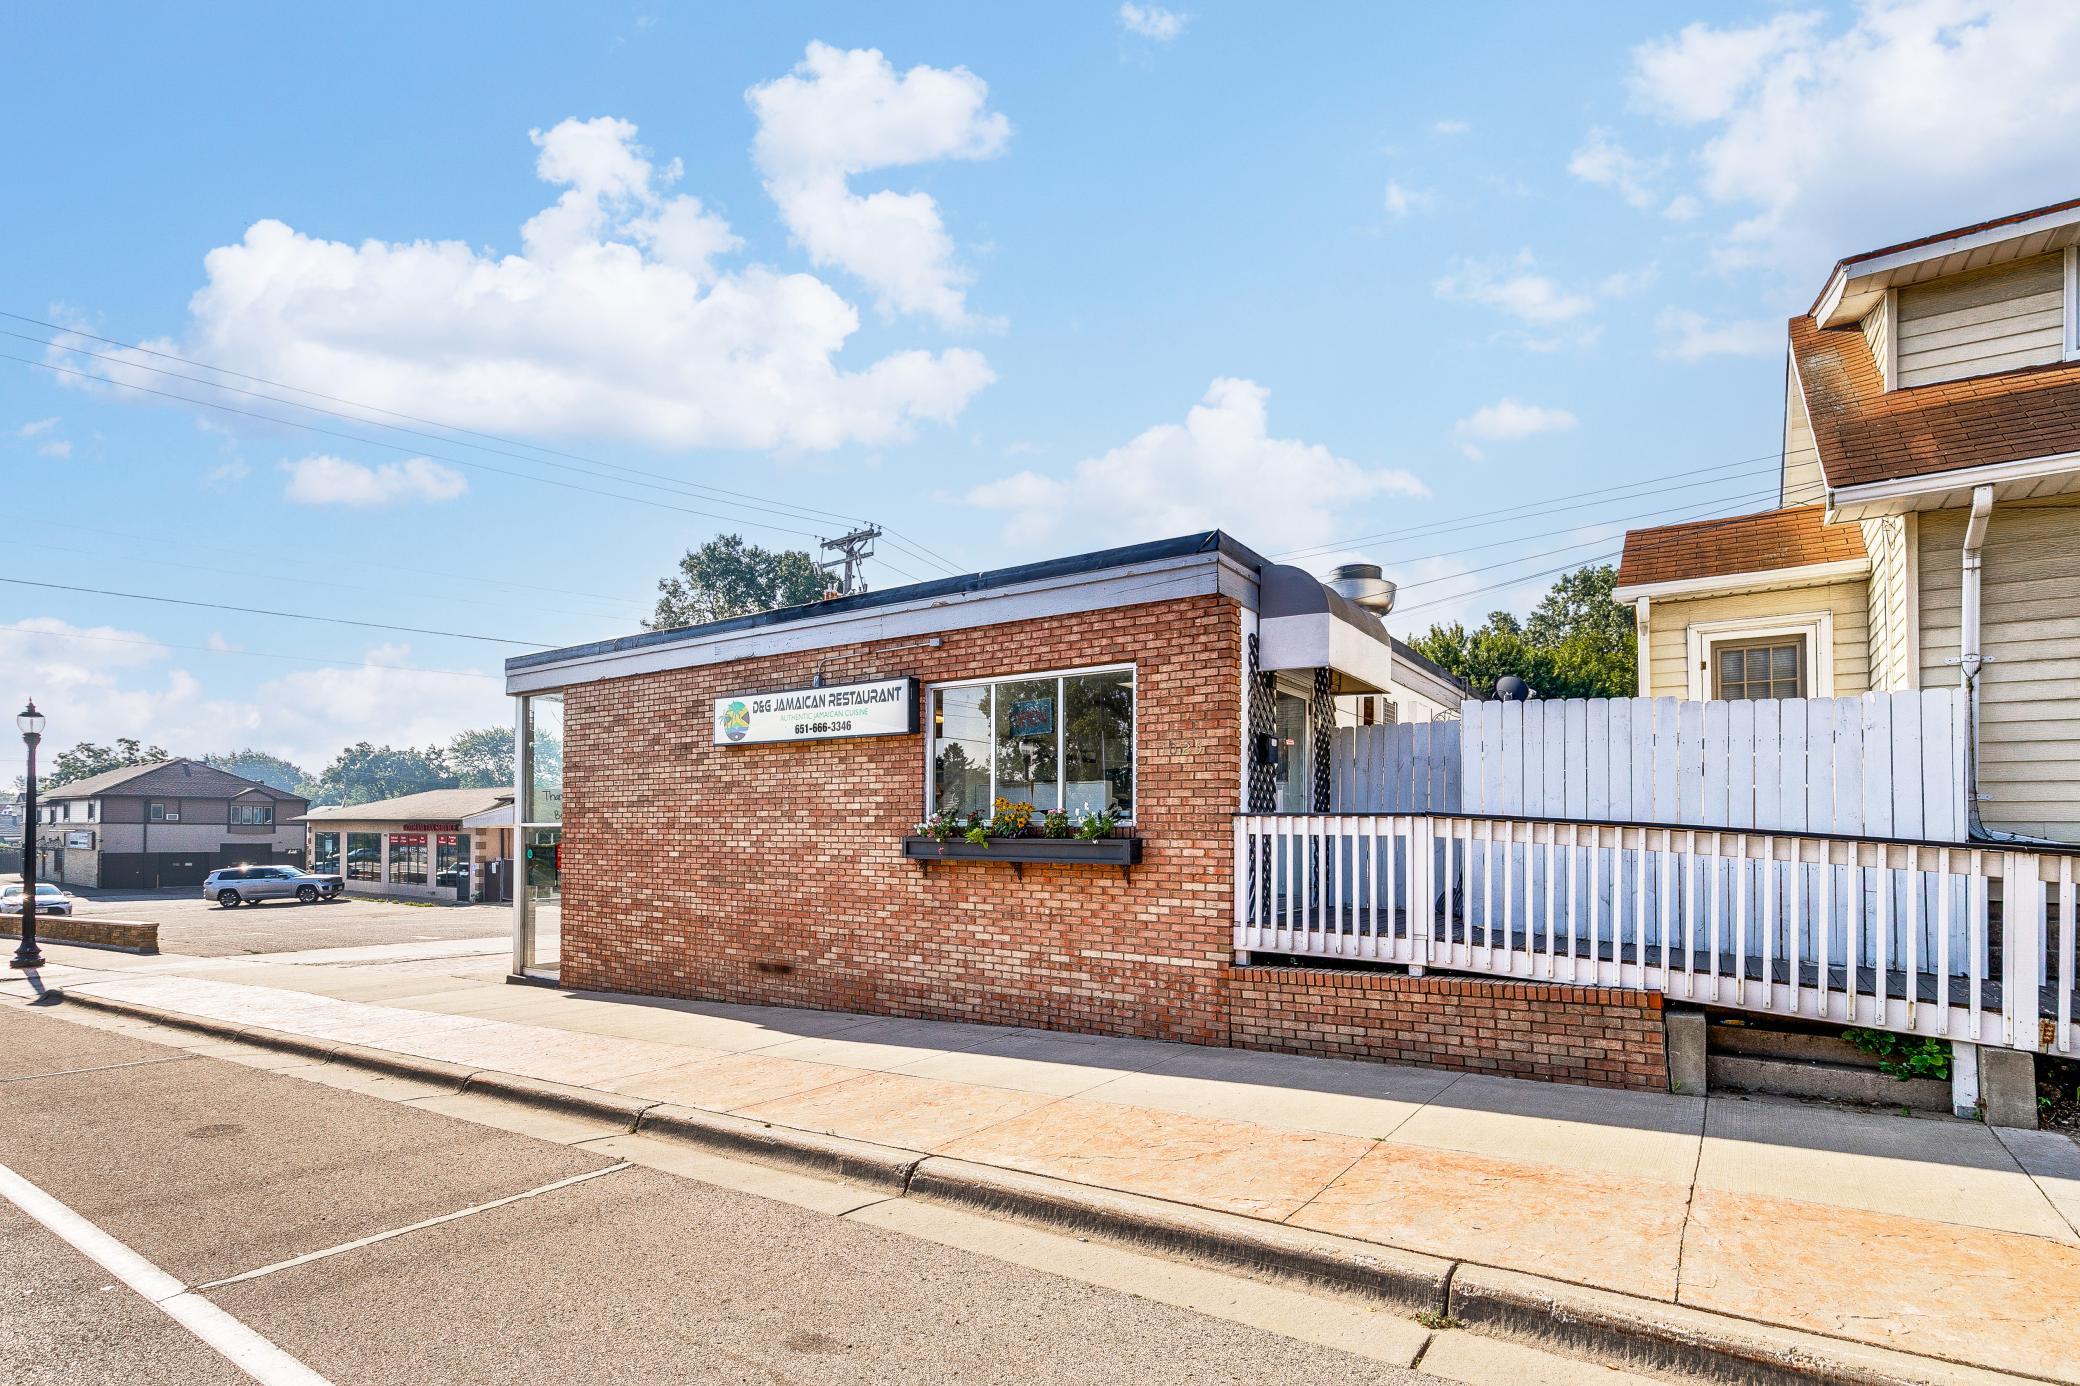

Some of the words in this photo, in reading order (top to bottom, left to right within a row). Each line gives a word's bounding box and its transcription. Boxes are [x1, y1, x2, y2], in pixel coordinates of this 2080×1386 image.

[752, 699, 772, 714] D&G
[774, 694, 826, 712] JAMAICAN
[828, 686, 902, 707] RESTAURANT
[780, 711, 812, 722] AUTHENTIC
[812, 709, 845, 721] JAMAICAN
[845, 707, 869, 717] CUISINE
[795, 720, 851, 734] 651-666-3346
